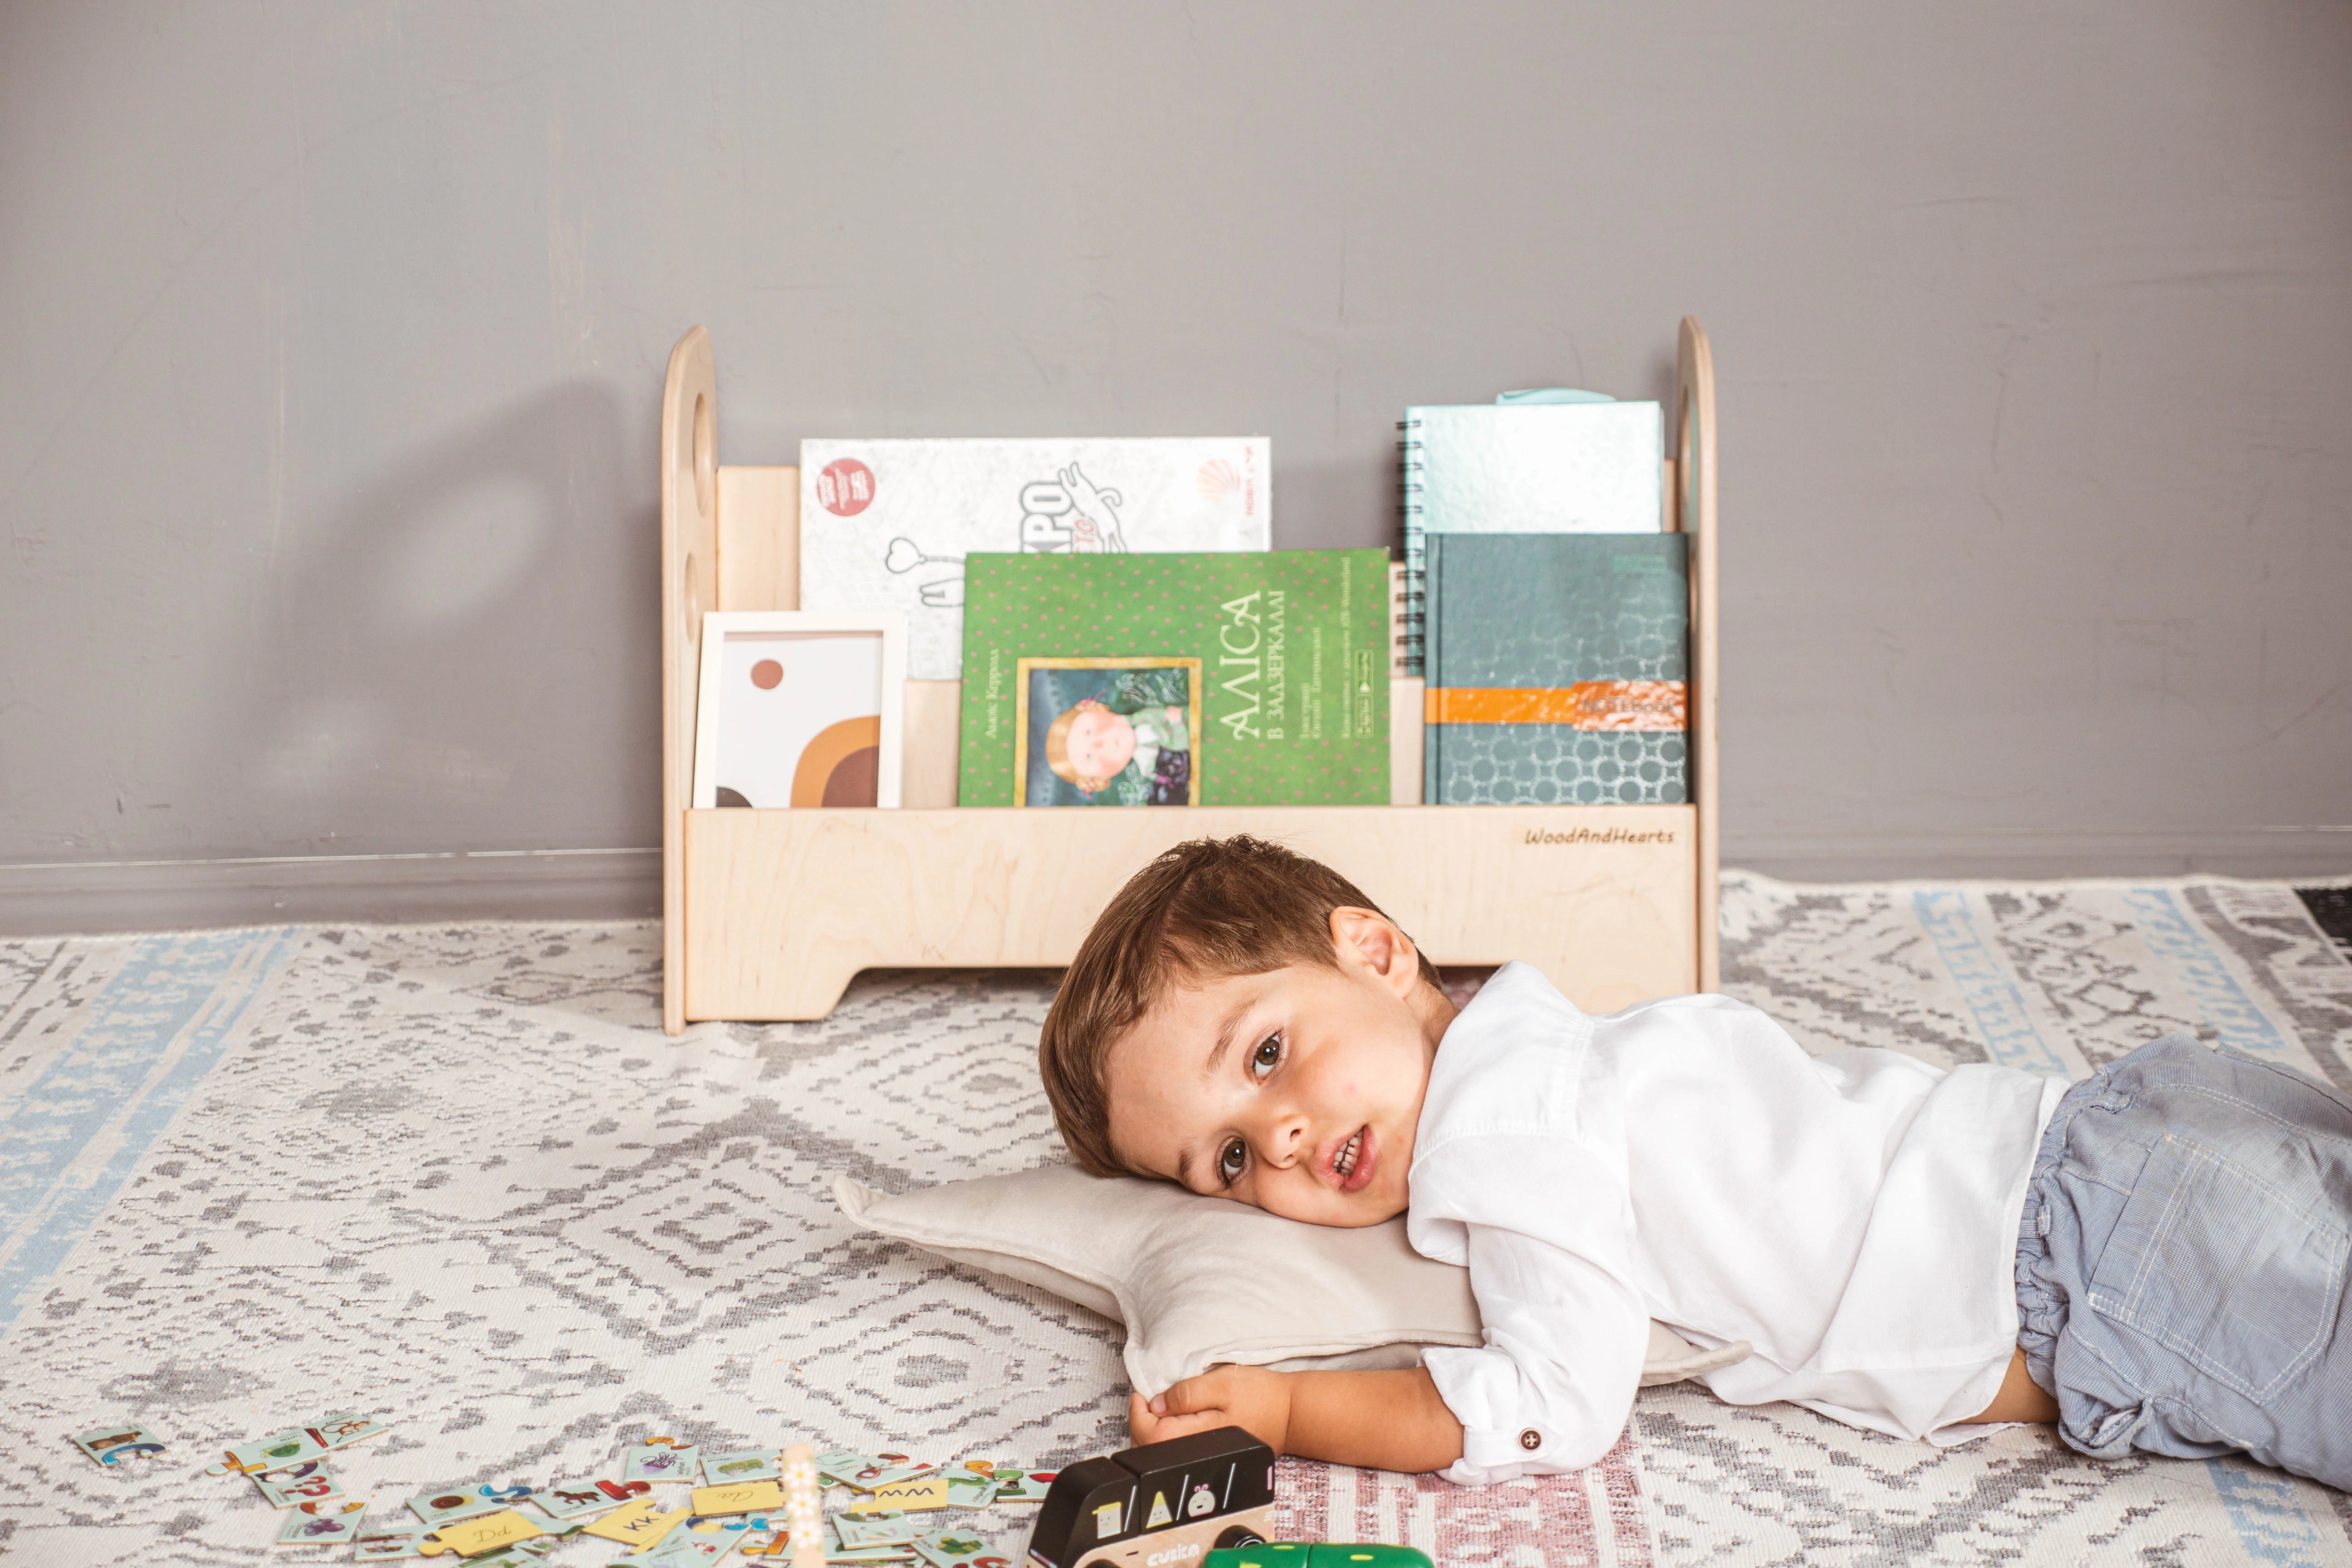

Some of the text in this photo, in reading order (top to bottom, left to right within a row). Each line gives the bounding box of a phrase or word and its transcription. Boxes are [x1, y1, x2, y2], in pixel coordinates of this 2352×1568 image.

[1220, 590, 1260, 741] АЛІСА
[1267, 590, 1285, 740] В ЗАДЗЕРКАЛЛІ
[1524, 826, 1675, 845] WoodAndHearts
[279, 1433, 304, 1442] Turtle
[473, 1525, 511, 1543] Dd
